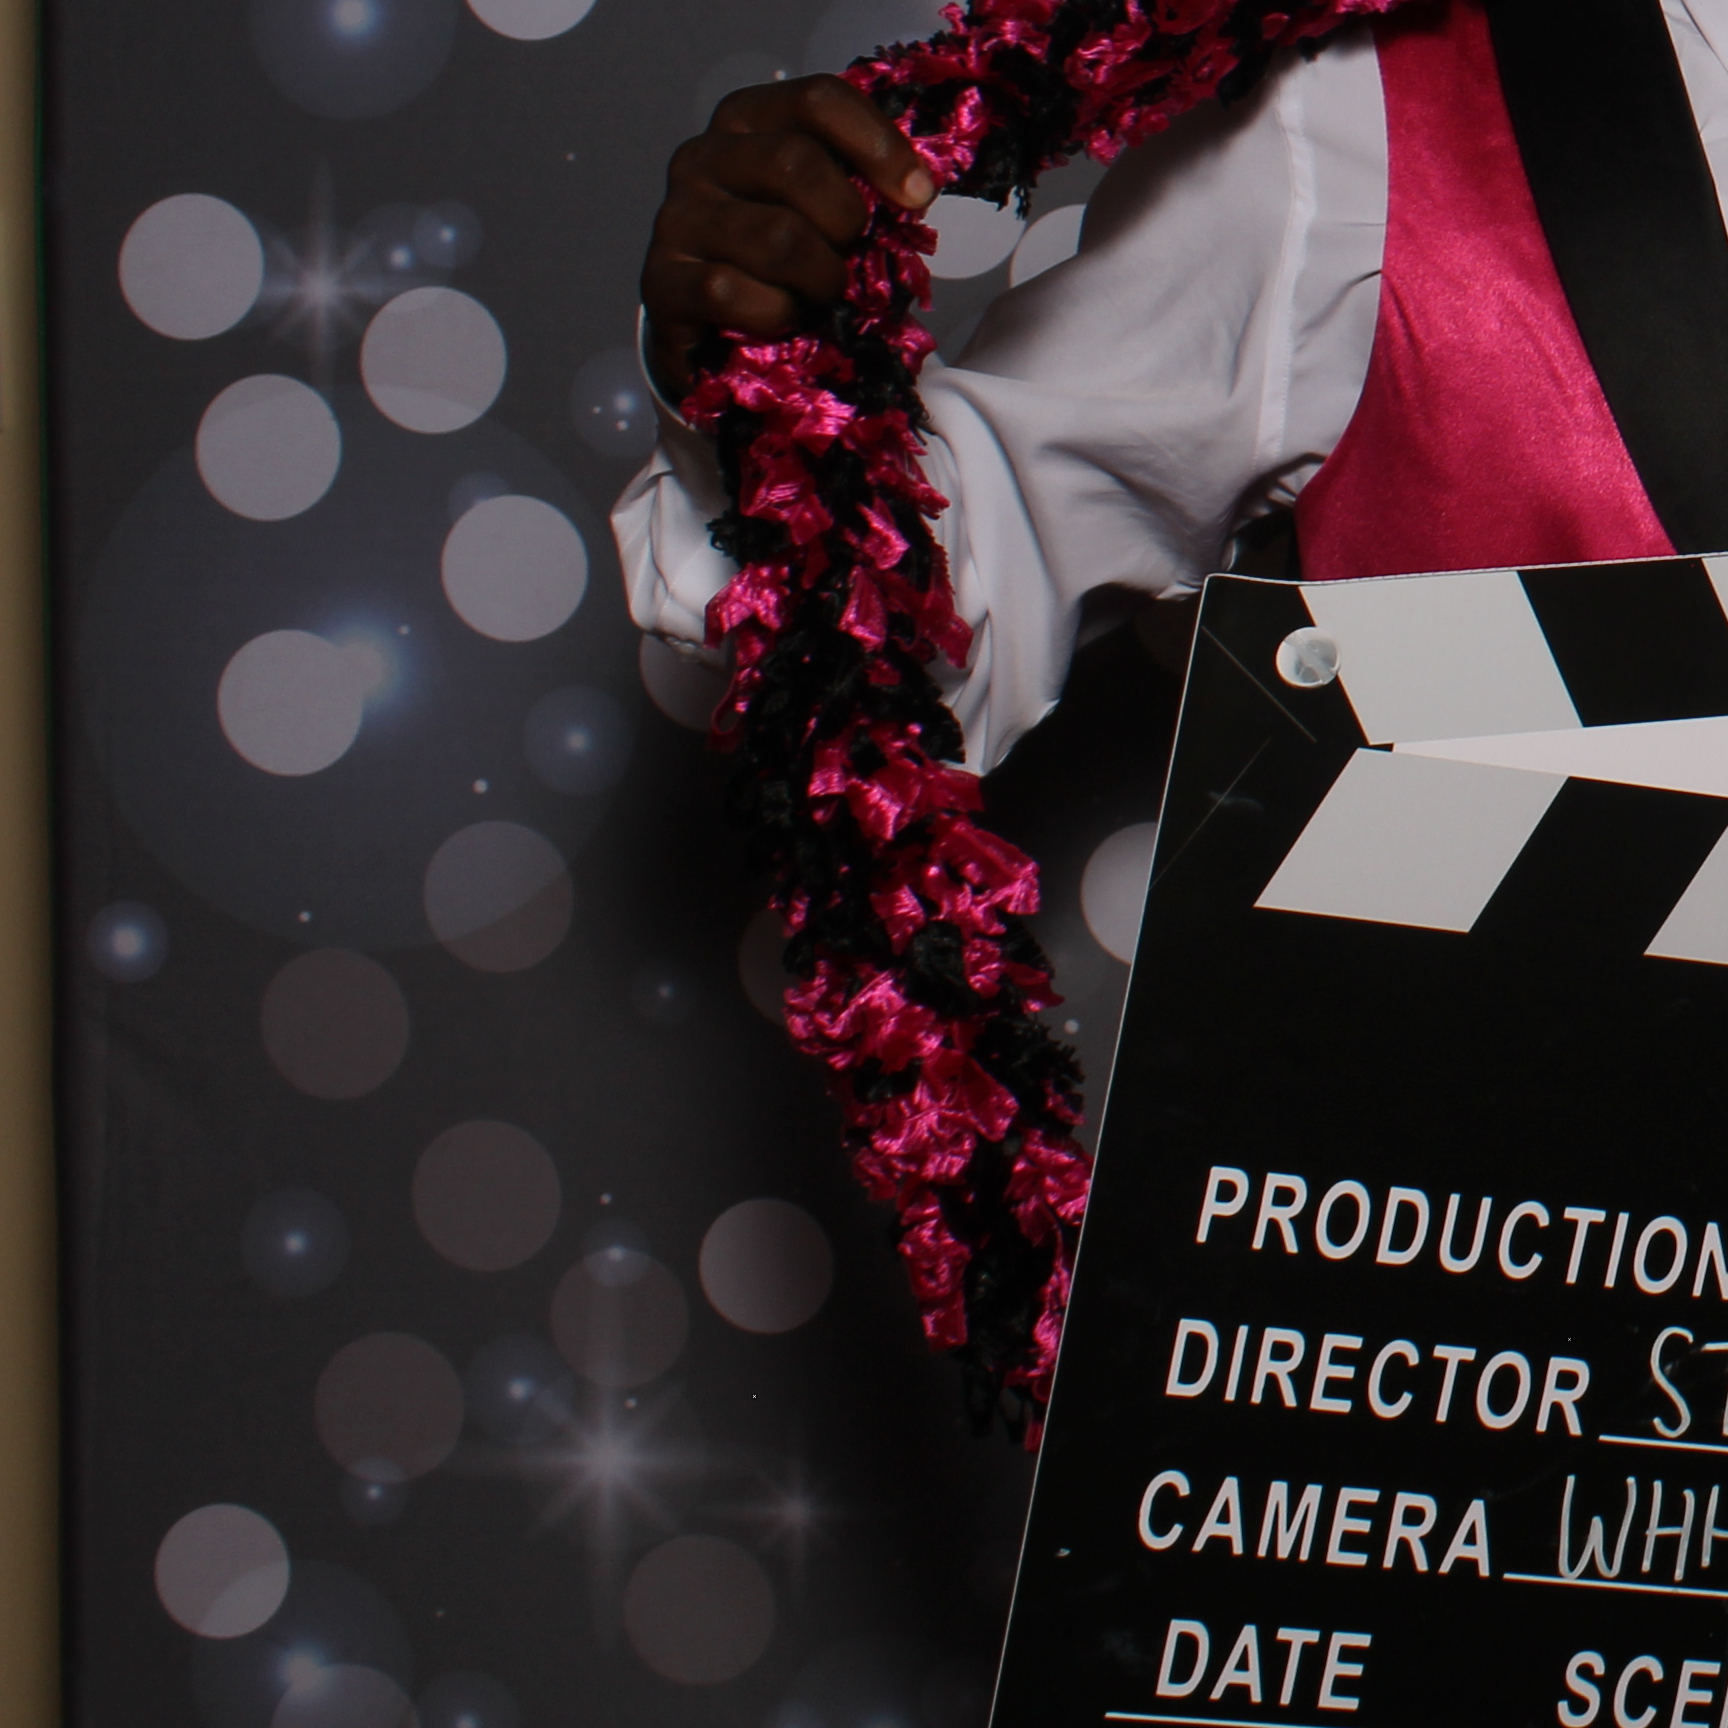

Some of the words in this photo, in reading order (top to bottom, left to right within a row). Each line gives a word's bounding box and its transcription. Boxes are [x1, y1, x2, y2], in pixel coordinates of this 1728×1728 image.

[1165, 1317, 1591, 1437] DIRECTOR
[1138, 1469, 1490, 1578] CAMERA
[1155, 1618, 1372, 1711] DATE
